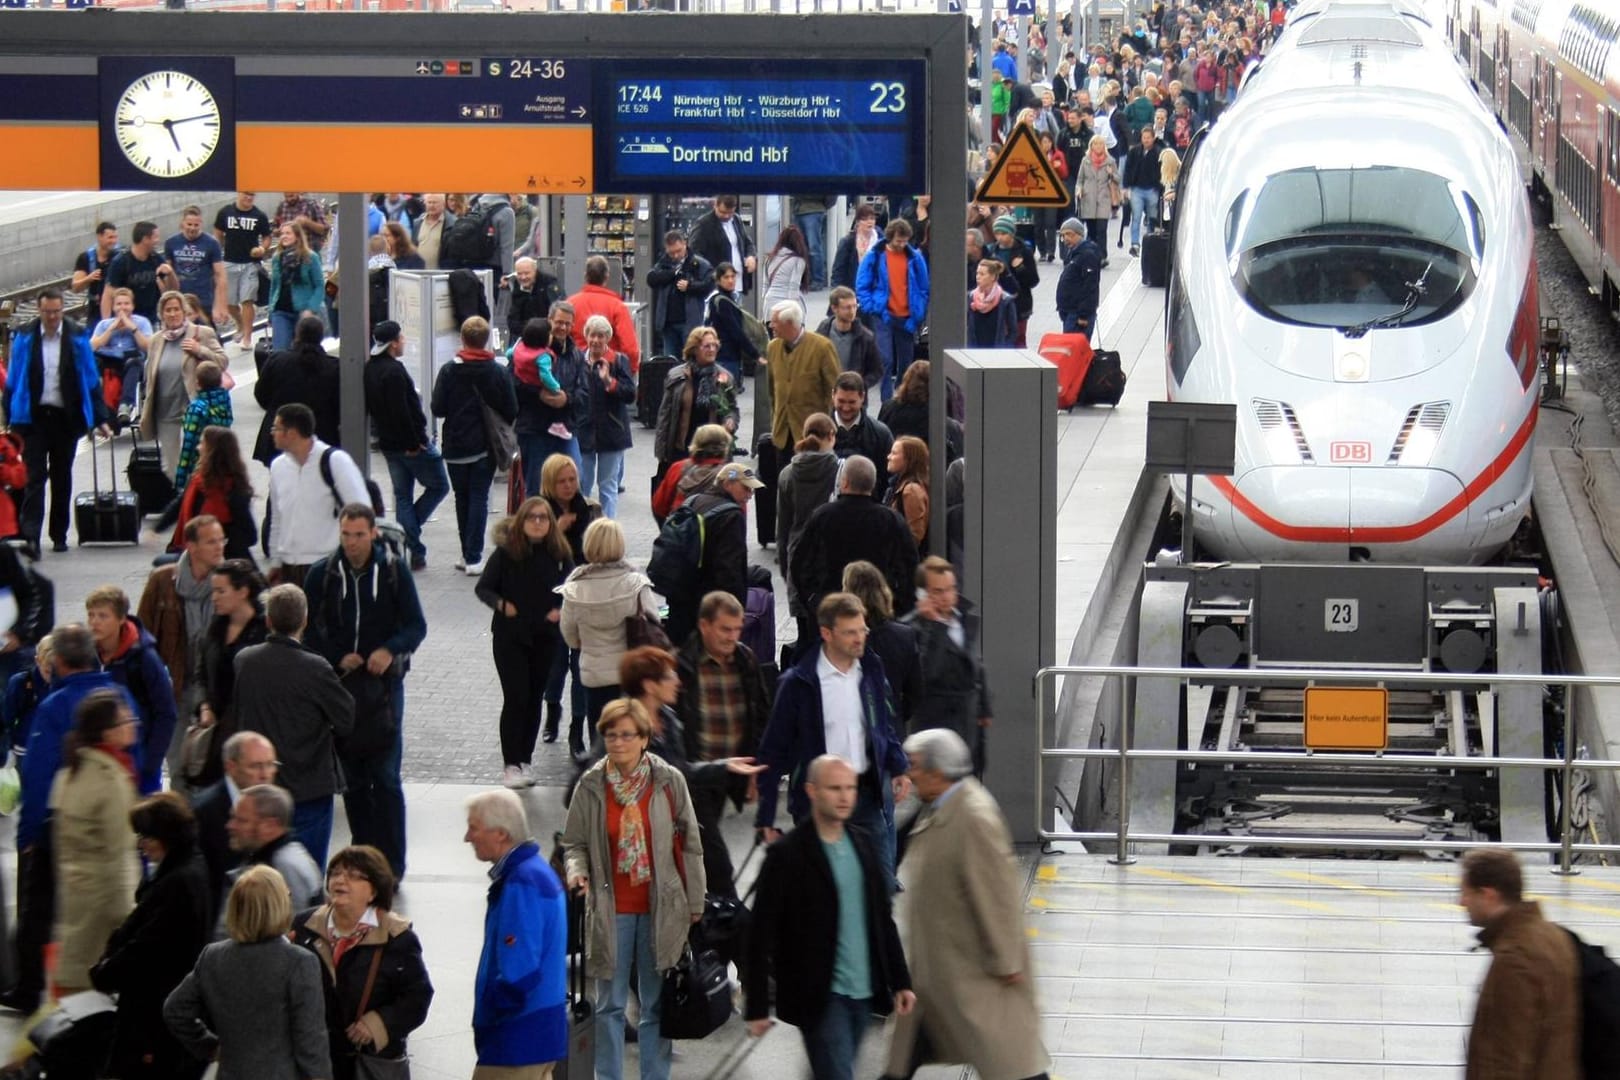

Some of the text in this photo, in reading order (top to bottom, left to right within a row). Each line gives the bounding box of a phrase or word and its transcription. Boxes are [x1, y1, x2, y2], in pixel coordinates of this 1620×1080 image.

[489, 62, 501, 76] S
[510, 60, 565, 79] 24-36
[619, 85, 662, 102] 17:44
[674, 95, 720, 107] Nürnberg
[723, 95, 742, 105] Hbf
[758, 95, 808, 107] Würzburg
[811, 95, 830, 105] Hbf
[869, 82, 906, 113] 23
[618, 104, 630, 113] ICE
[674, 107, 722, 117] Frankfurt
[727, 107, 745, 117] Hbf
[761, 108, 818, 118] Düsseldorf
[822, 108, 841, 118] Hbf
[673, 146, 753, 162] Dortmund
[761, 146, 789, 162] Hbf
[1335, 444, 1367, 459] DB
[1332, 604, 1352, 624] 23
